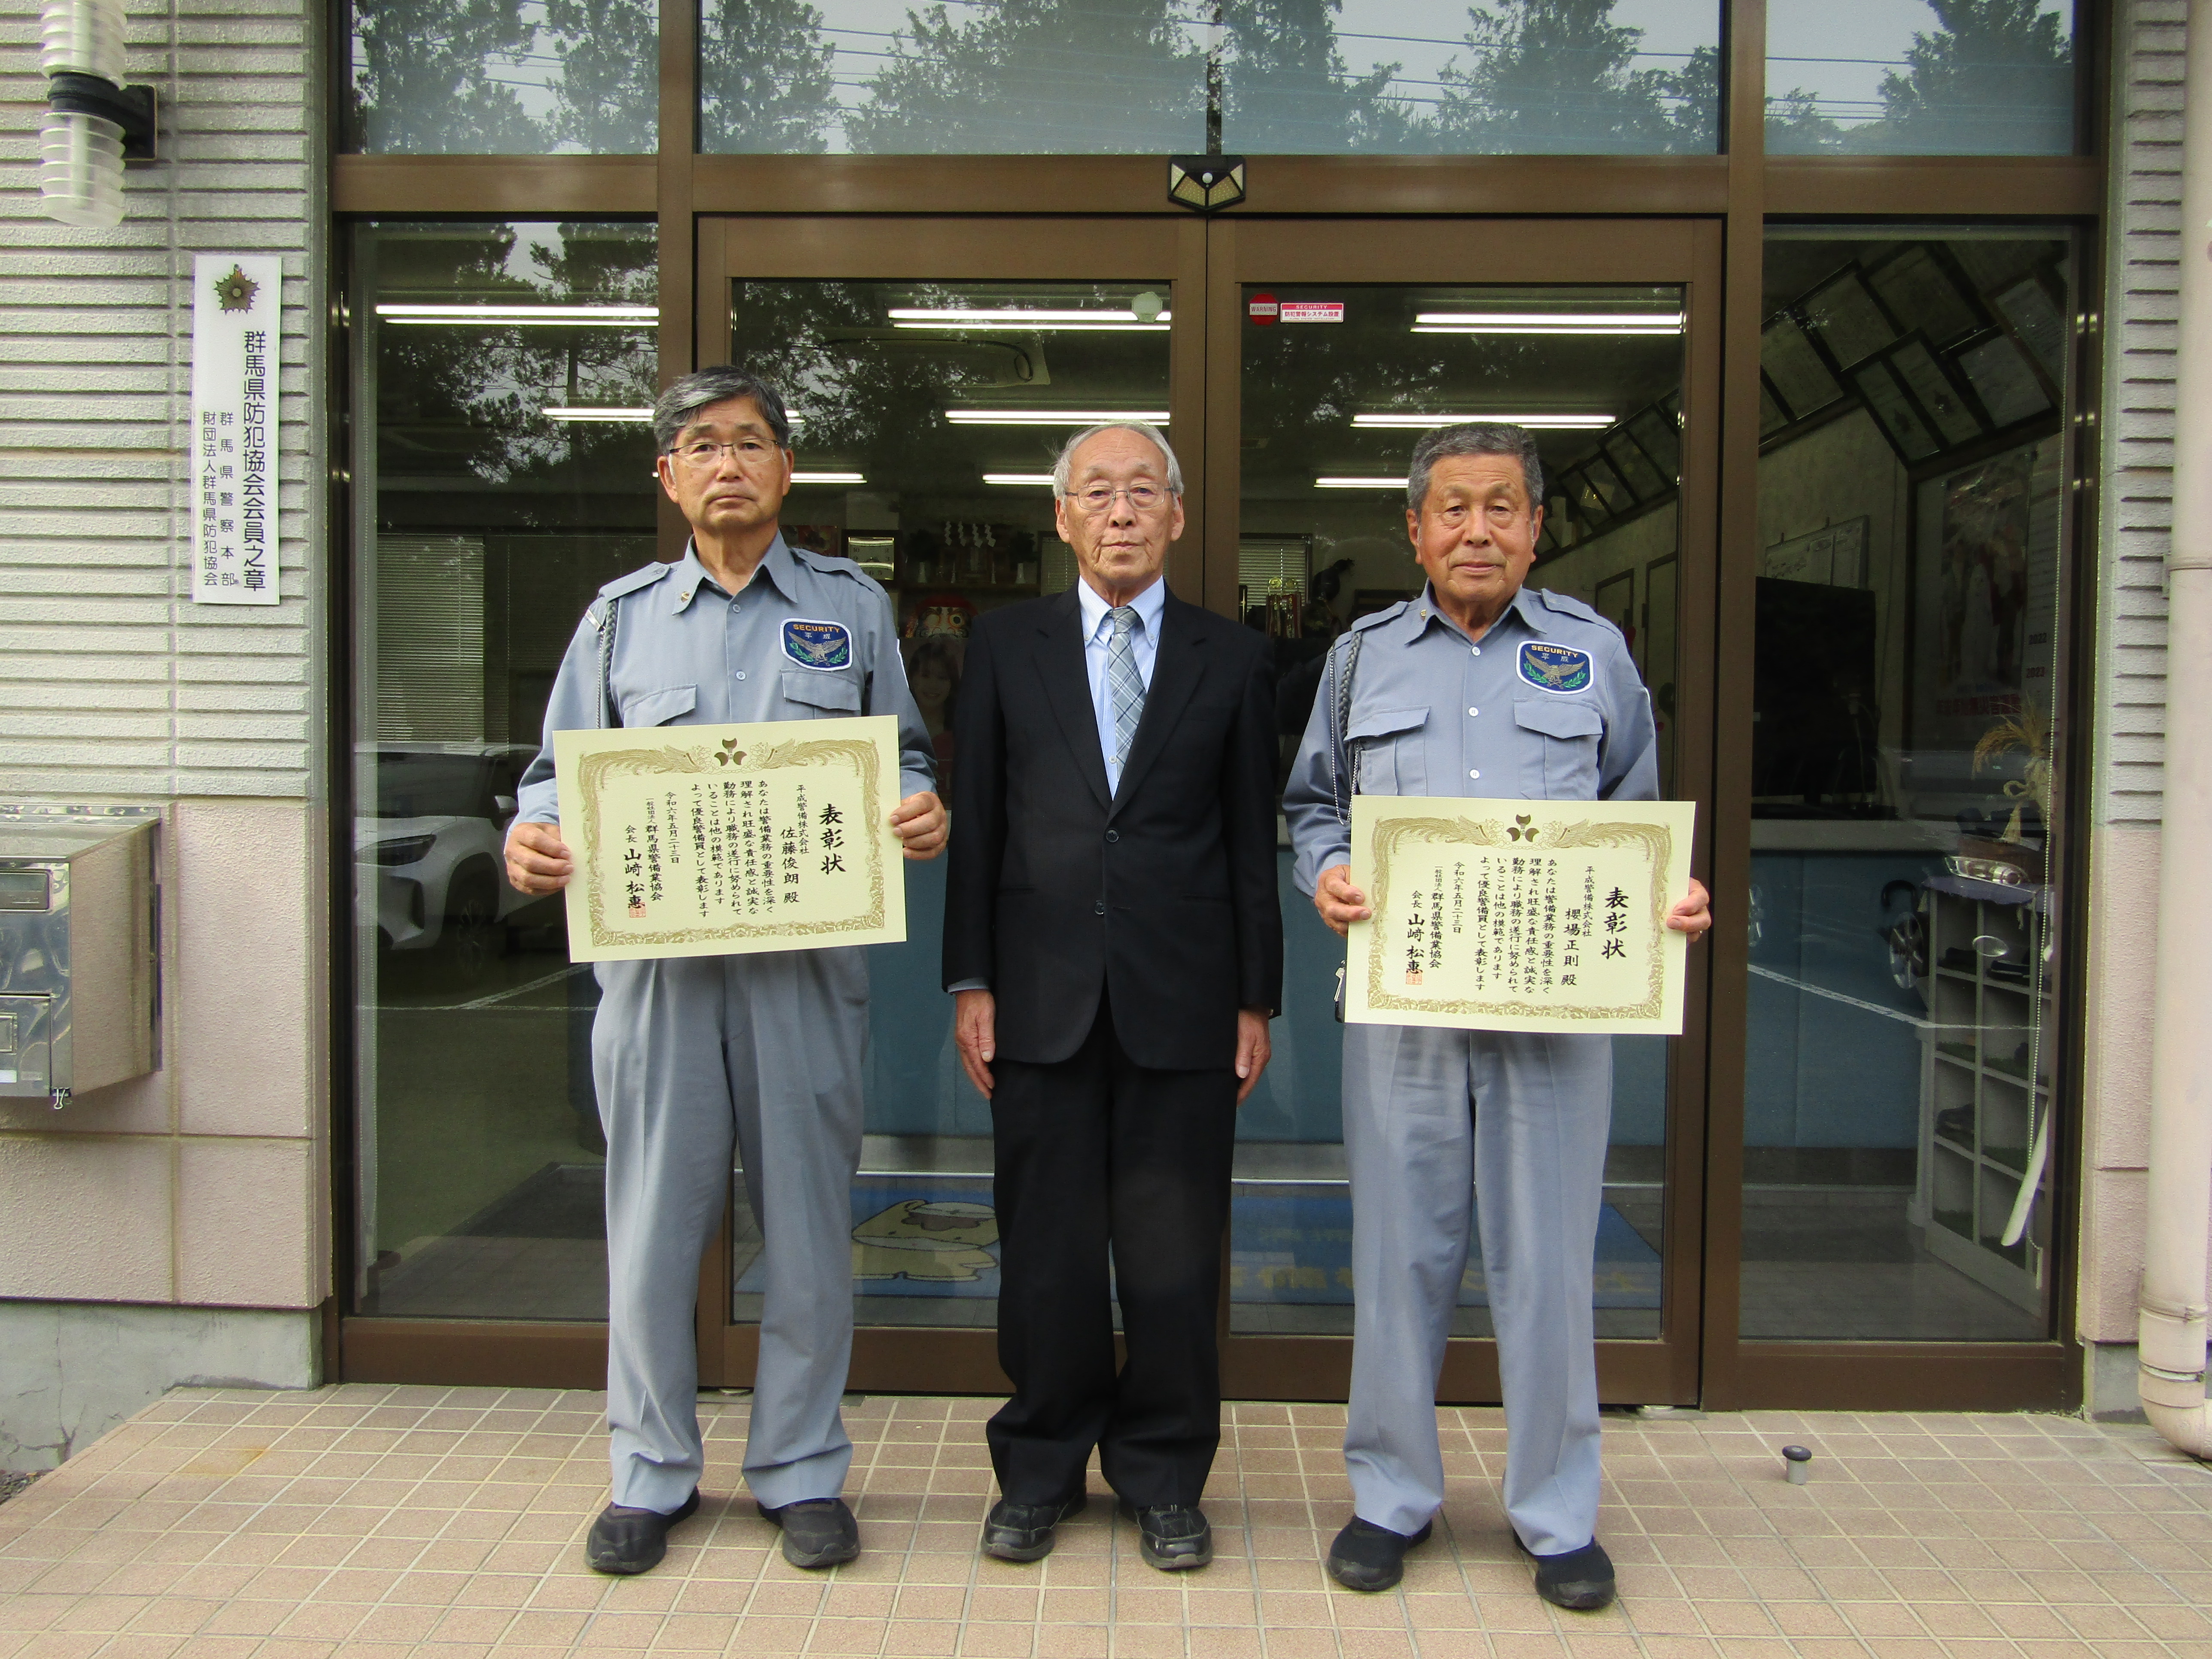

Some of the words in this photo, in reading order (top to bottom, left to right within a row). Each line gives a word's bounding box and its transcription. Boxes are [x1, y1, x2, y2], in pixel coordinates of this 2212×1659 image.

[202, 411, 218, 586] 財団法人群馬県防犯協会
[219, 411, 234, 586] 群馬県警察本部
[242, 330, 267, 592] 群馬県防犯協会会員之章
[793, 624, 840, 633] SECURITY
[1531, 645, 1579, 658] SECURITY
[625, 825, 638, 843] 会長
[665, 791, 681, 864] 令和六年五月二十三日
[690, 784, 709, 918] よって優良警備員として表彰します
[708, 784, 725, 905] いることは他の模範であります
[723, 781, 742, 915] 勤務により職務の遂行に努められて
[740, 780, 760, 915] 理解され旺盛な責任感と誠実な
[758, 780, 776, 913] あなたは警備業務の重要性を深く
[796, 784, 810, 855] 平成警備株式会社
[818, 803, 846, 875] 表彰状
[783, 891, 800, 904] 殿
[1411, 890, 1423, 908] 会長
[1452, 861, 1465, 934] 令和六年五月二十三日
[1474, 857, 1491, 991] よって優良警備員として表彰します
[1492, 857, 1507, 979] いることは他の模範であります
[1507, 857, 1525, 993] 勤務により職務の遂行に努められて
[1523, 858, 1542, 994] 理解され旺盛な責任感と誠実な
[1540, 859, 1558, 994] あなたは警備業務の重要性を深く
[1582, 866, 1595, 937] 平成警備株式会社
[1601, 887, 1629, 960] 表彰状
[1561, 974, 1577, 986] 殿
